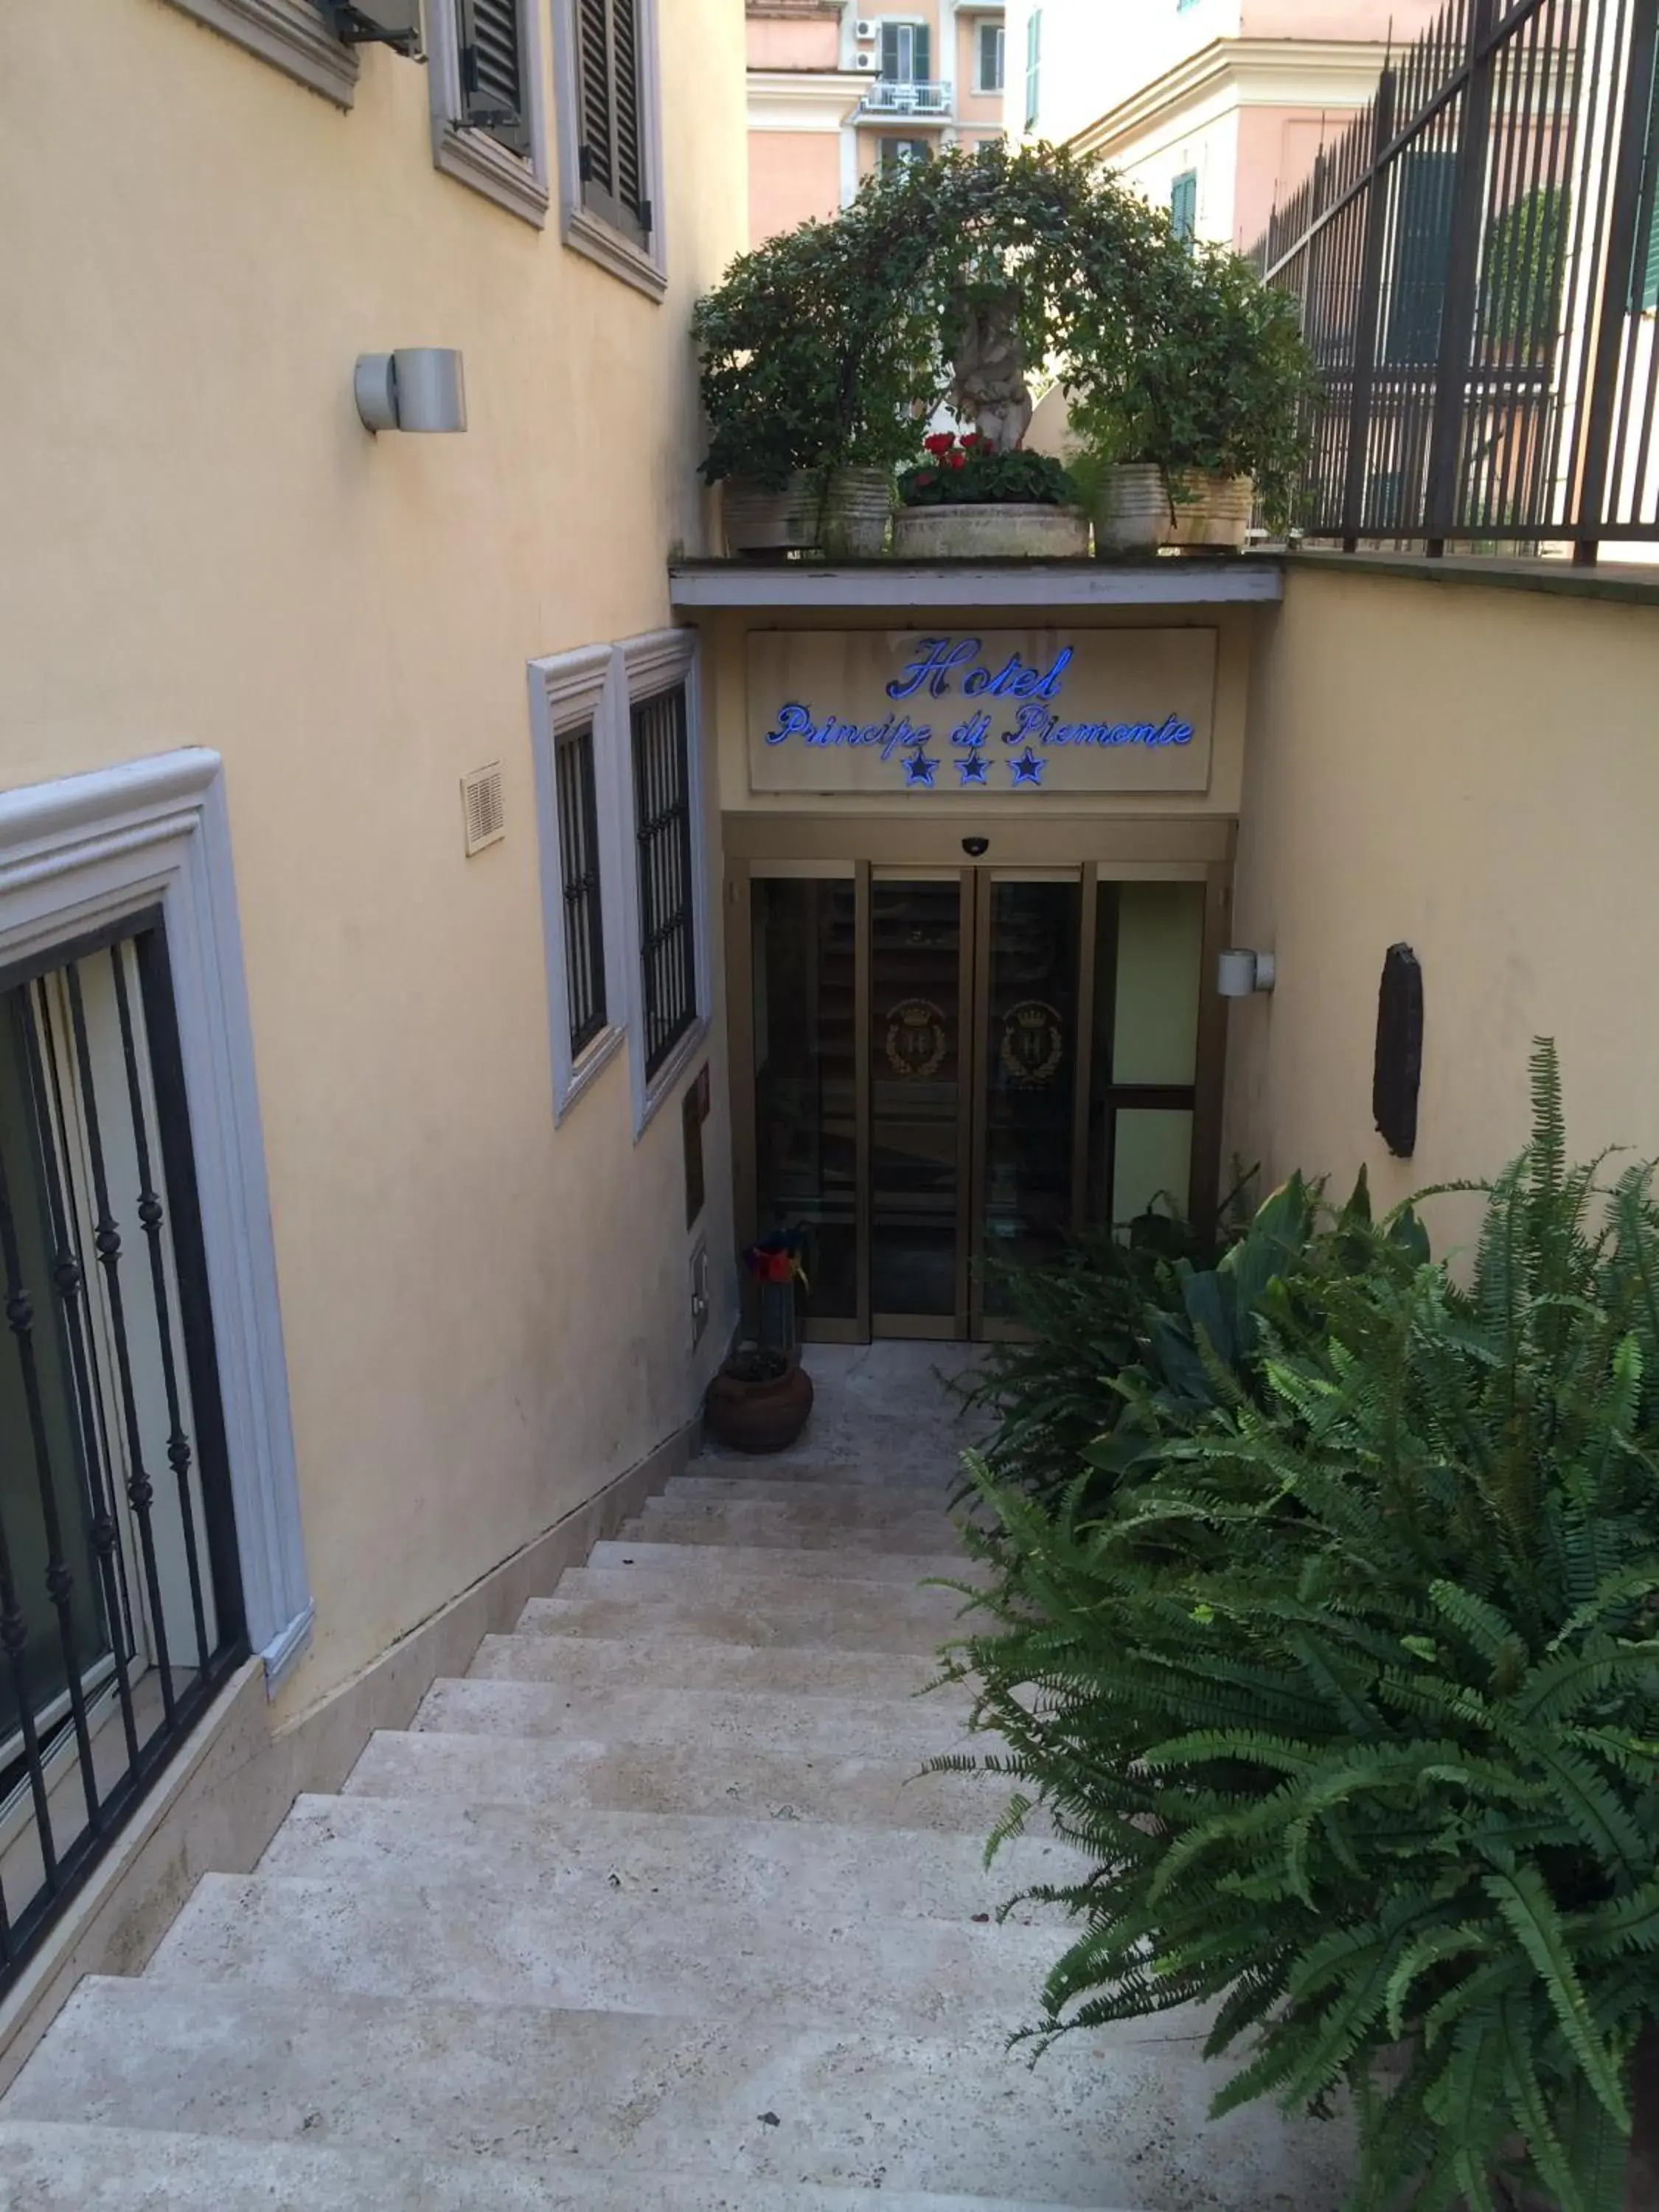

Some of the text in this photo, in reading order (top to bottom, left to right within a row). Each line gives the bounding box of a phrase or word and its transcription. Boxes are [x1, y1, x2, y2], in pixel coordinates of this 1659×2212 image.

[886, 637, 1074, 700] Hotel
[766, 702, 1194, 760] Principe di Piemonte
